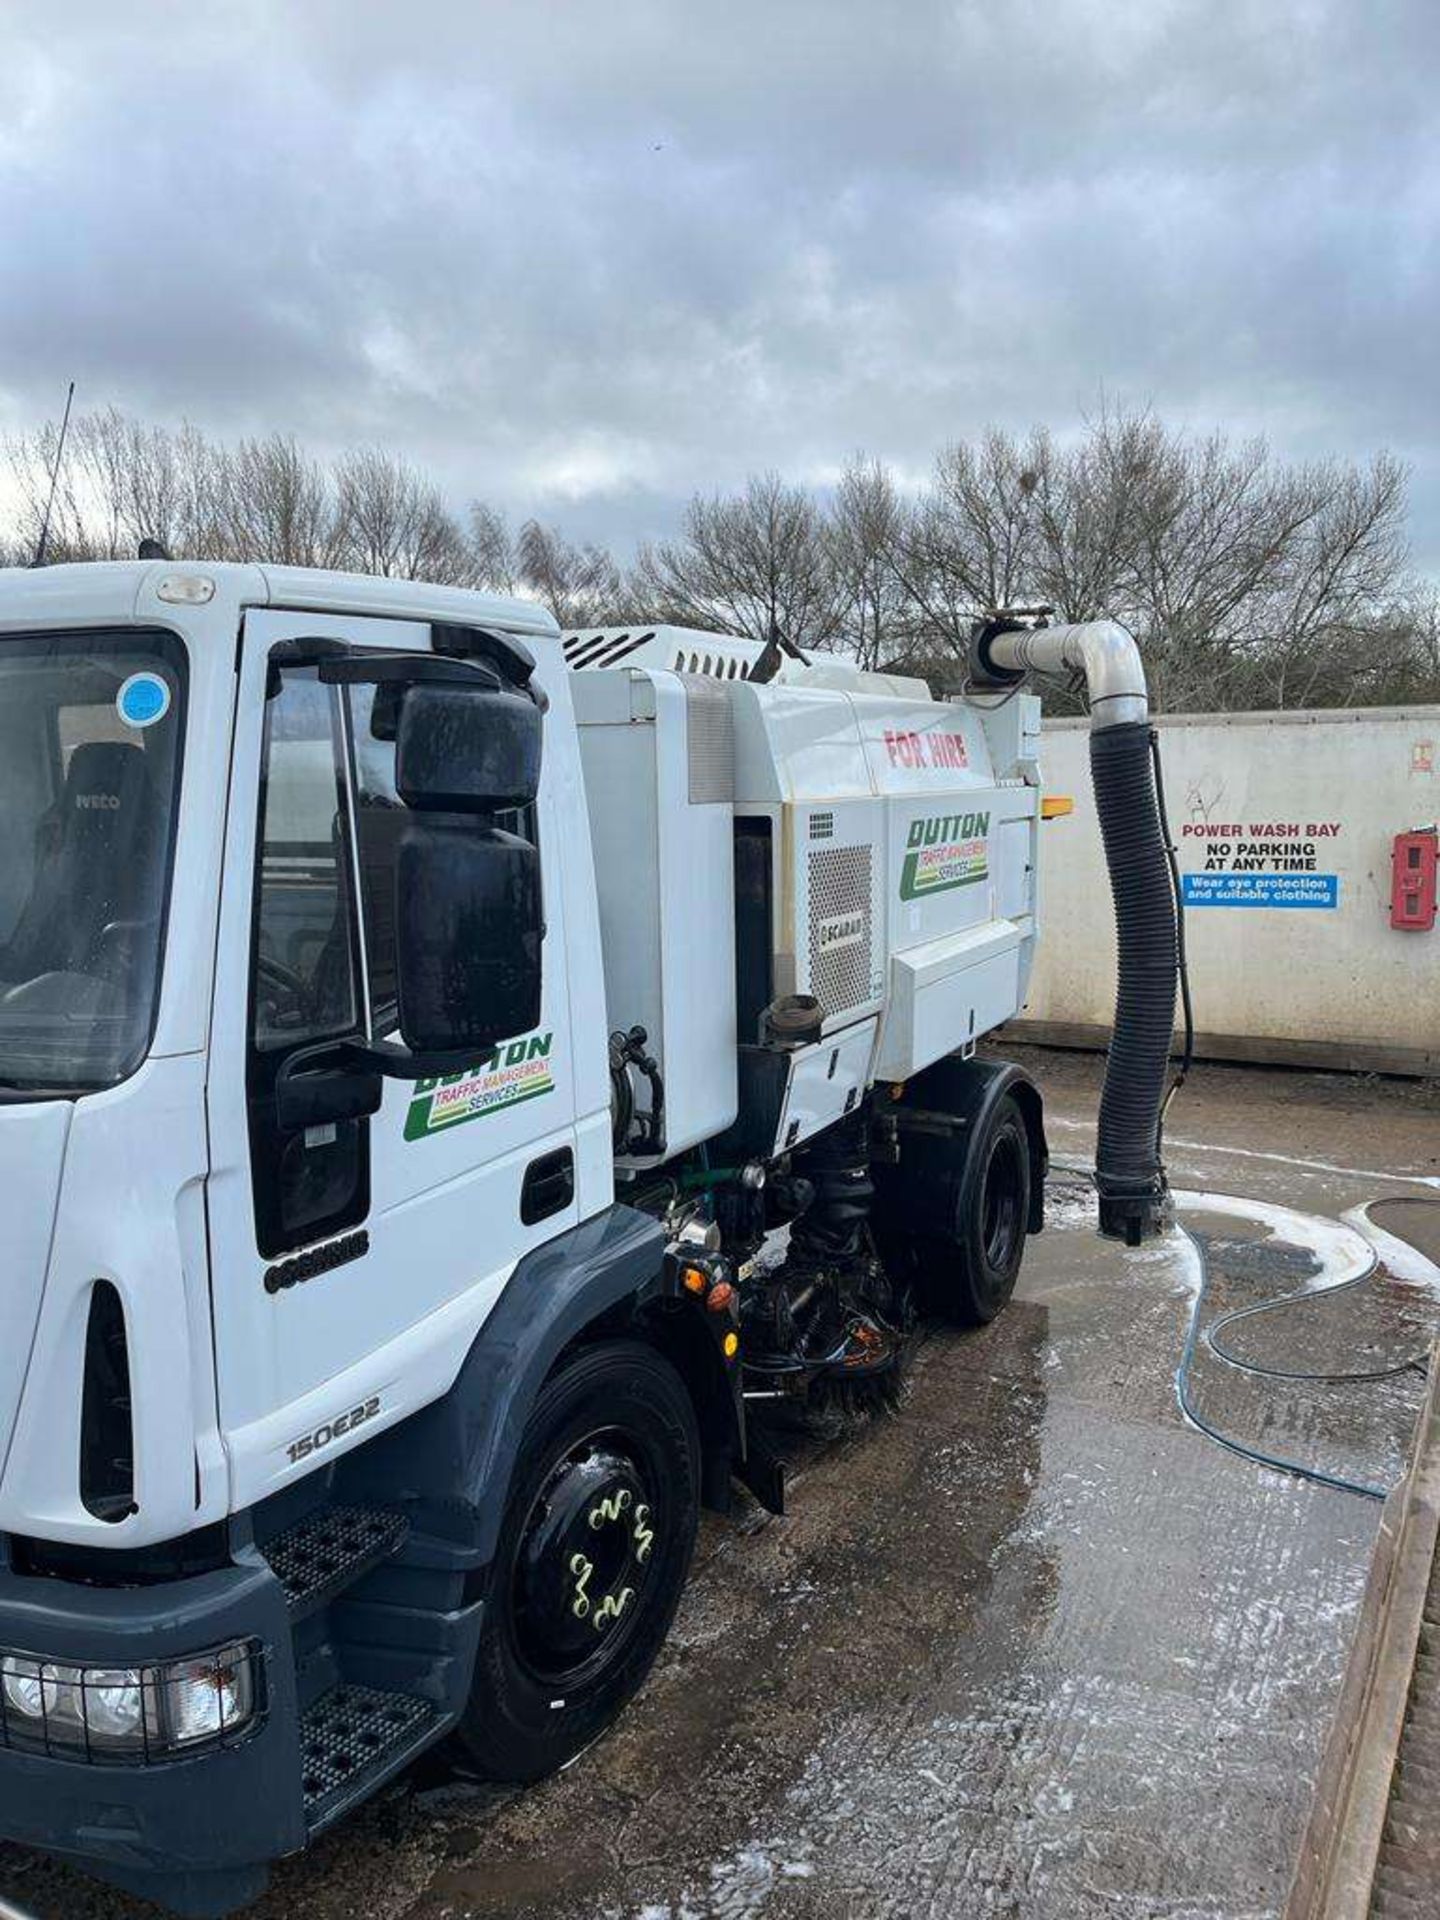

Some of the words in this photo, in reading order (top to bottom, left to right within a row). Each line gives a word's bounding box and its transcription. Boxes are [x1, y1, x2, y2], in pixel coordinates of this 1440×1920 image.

[884, 731, 926, 768] FOR
[927, 732, 968, 768] HIRE
[76, 795, 120, 809] IVECO
[907, 812, 990, 848] DUTTON
[1182, 824, 1243, 837] POWER
[1250, 824, 1299, 837] WASH
[1306, 824, 1341, 837] BAY
[1207, 844, 1231, 856] NO
[1237, 843, 1315, 856] PARKING
[1205, 859, 1226, 871] AT
[1231, 858, 1265, 871] ANY
[1272, 858, 1316, 871] TIME
[1192, 877, 1224, 888] Wear
[1227, 879, 1251, 890] eye
[1255, 877, 1328, 889] protection
[1188, 889, 1212, 899] and
[1216, 889, 1270, 899] suitable
[1273, 889, 1331, 902] clothing
[436, 1080, 481, 1105] TRAFFIC
[483, 1059, 550, 1089] MANAGEMENT
[469, 1083, 519, 1111] SERVICES
[287, 1397, 380, 1463] 150E22
